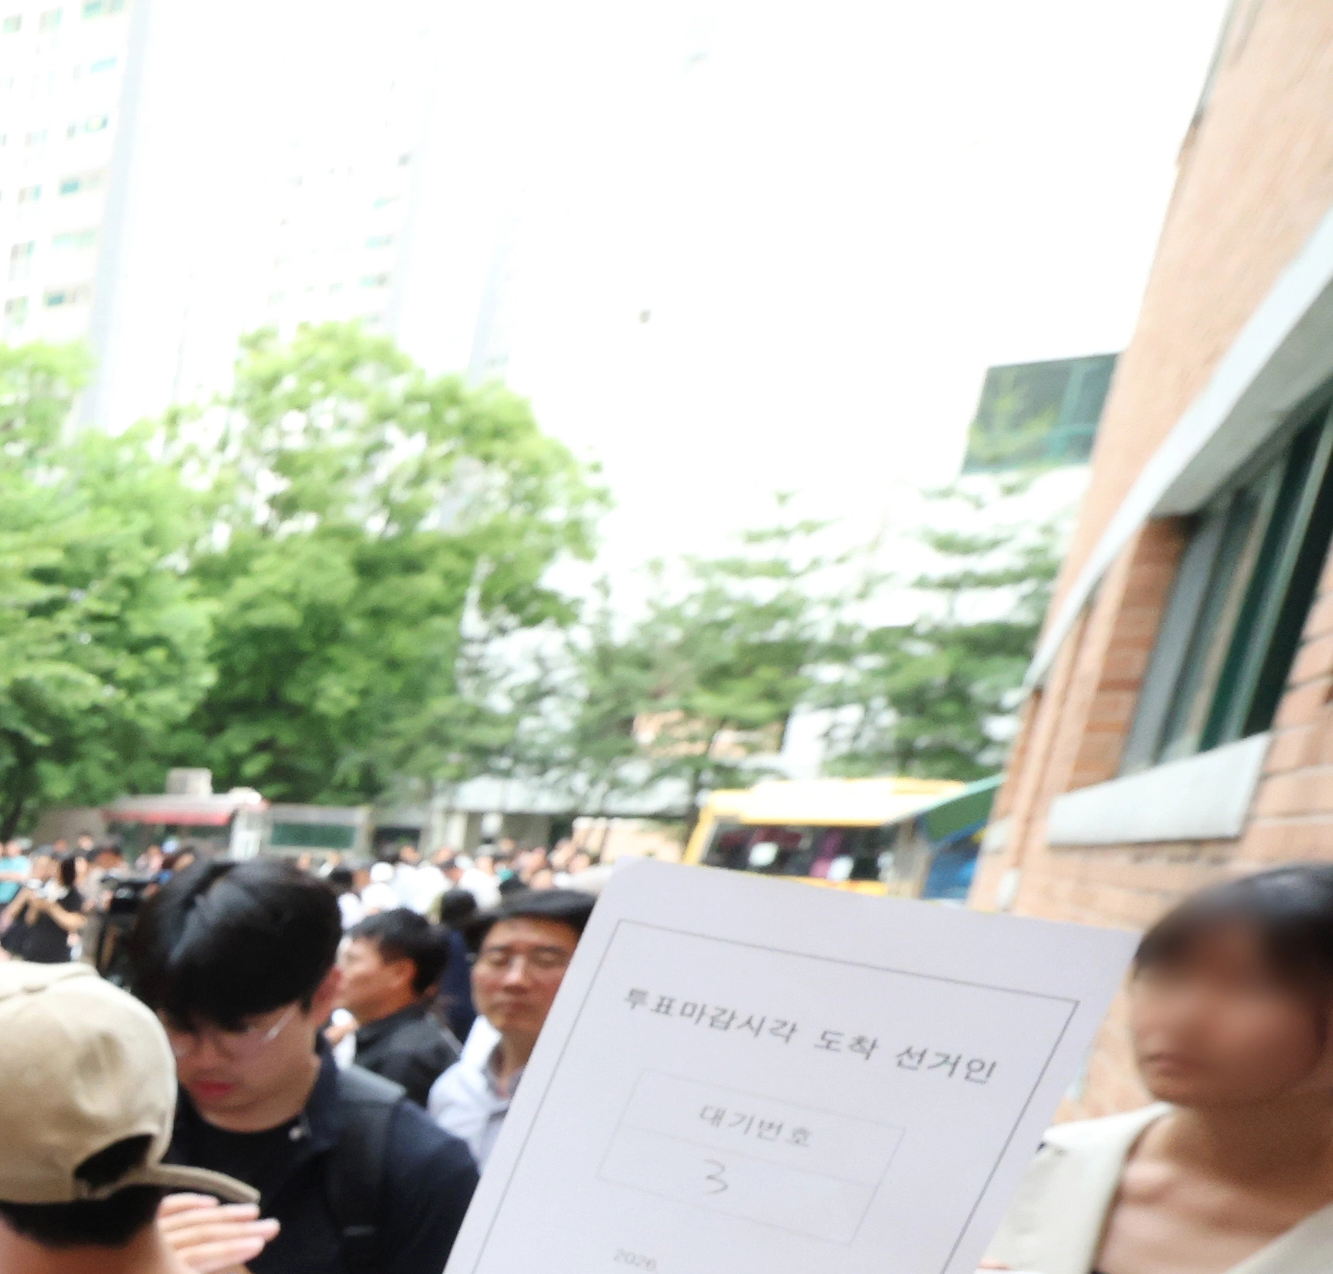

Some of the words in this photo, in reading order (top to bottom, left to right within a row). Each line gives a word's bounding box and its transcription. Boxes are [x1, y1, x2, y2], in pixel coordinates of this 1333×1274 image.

[624, 987, 799, 1045] 투표마감시각
[813, 1029, 880, 1061] 도착
[895, 1045, 998, 1086] 선거인
[698, 1104, 813, 1148] 대기번호
[704, 1158, 729, 1194] 3
